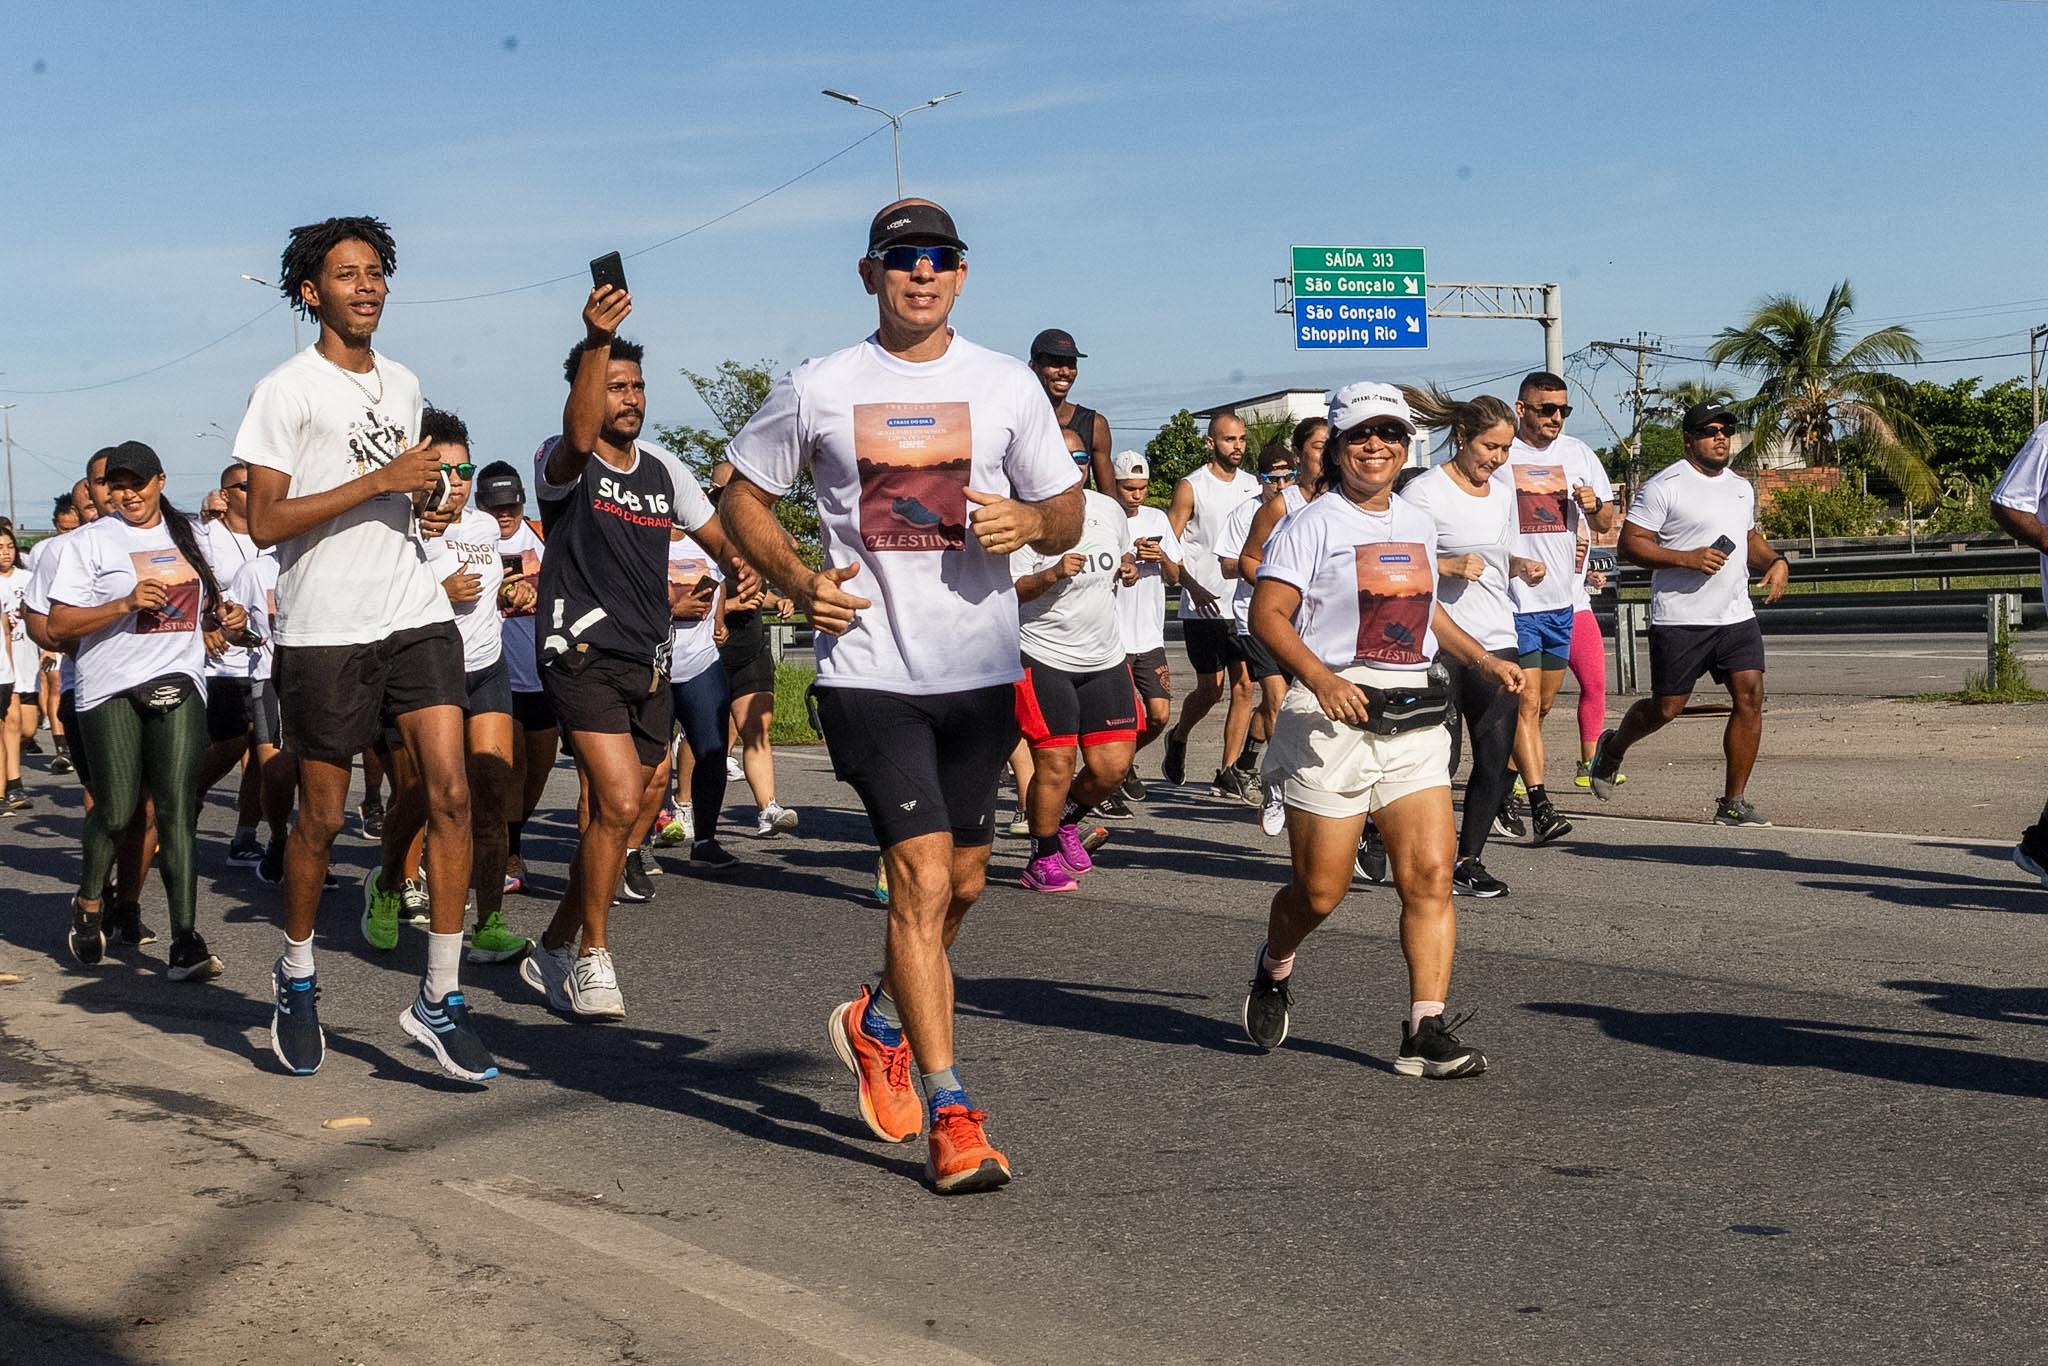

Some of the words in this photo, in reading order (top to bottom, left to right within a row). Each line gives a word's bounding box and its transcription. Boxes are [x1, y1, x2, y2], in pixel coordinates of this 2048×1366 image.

[1325, 248, 1364, 267] SAÍDA
[1372, 253, 1394, 267] 313
[1305, 277, 1331, 292] São
[1337, 277, 1395, 294] Gonçalo
[1306, 305, 1333, 320] São
[1339, 305, 1396, 322] Gonçalo
[1301, 326, 1368, 344] Shopping
[1375, 326, 1397, 340] Rio
[598, 477, 643, 511] SUB
[645, 493, 670, 514] 16
[593, 499, 623, 516] 2.500
[1520, 524, 1566, 533] CELESTINO
[457, 552, 493, 565] LAND
[1081, 552, 1114, 574] IO
[149, 621, 195, 633] ESTINO
